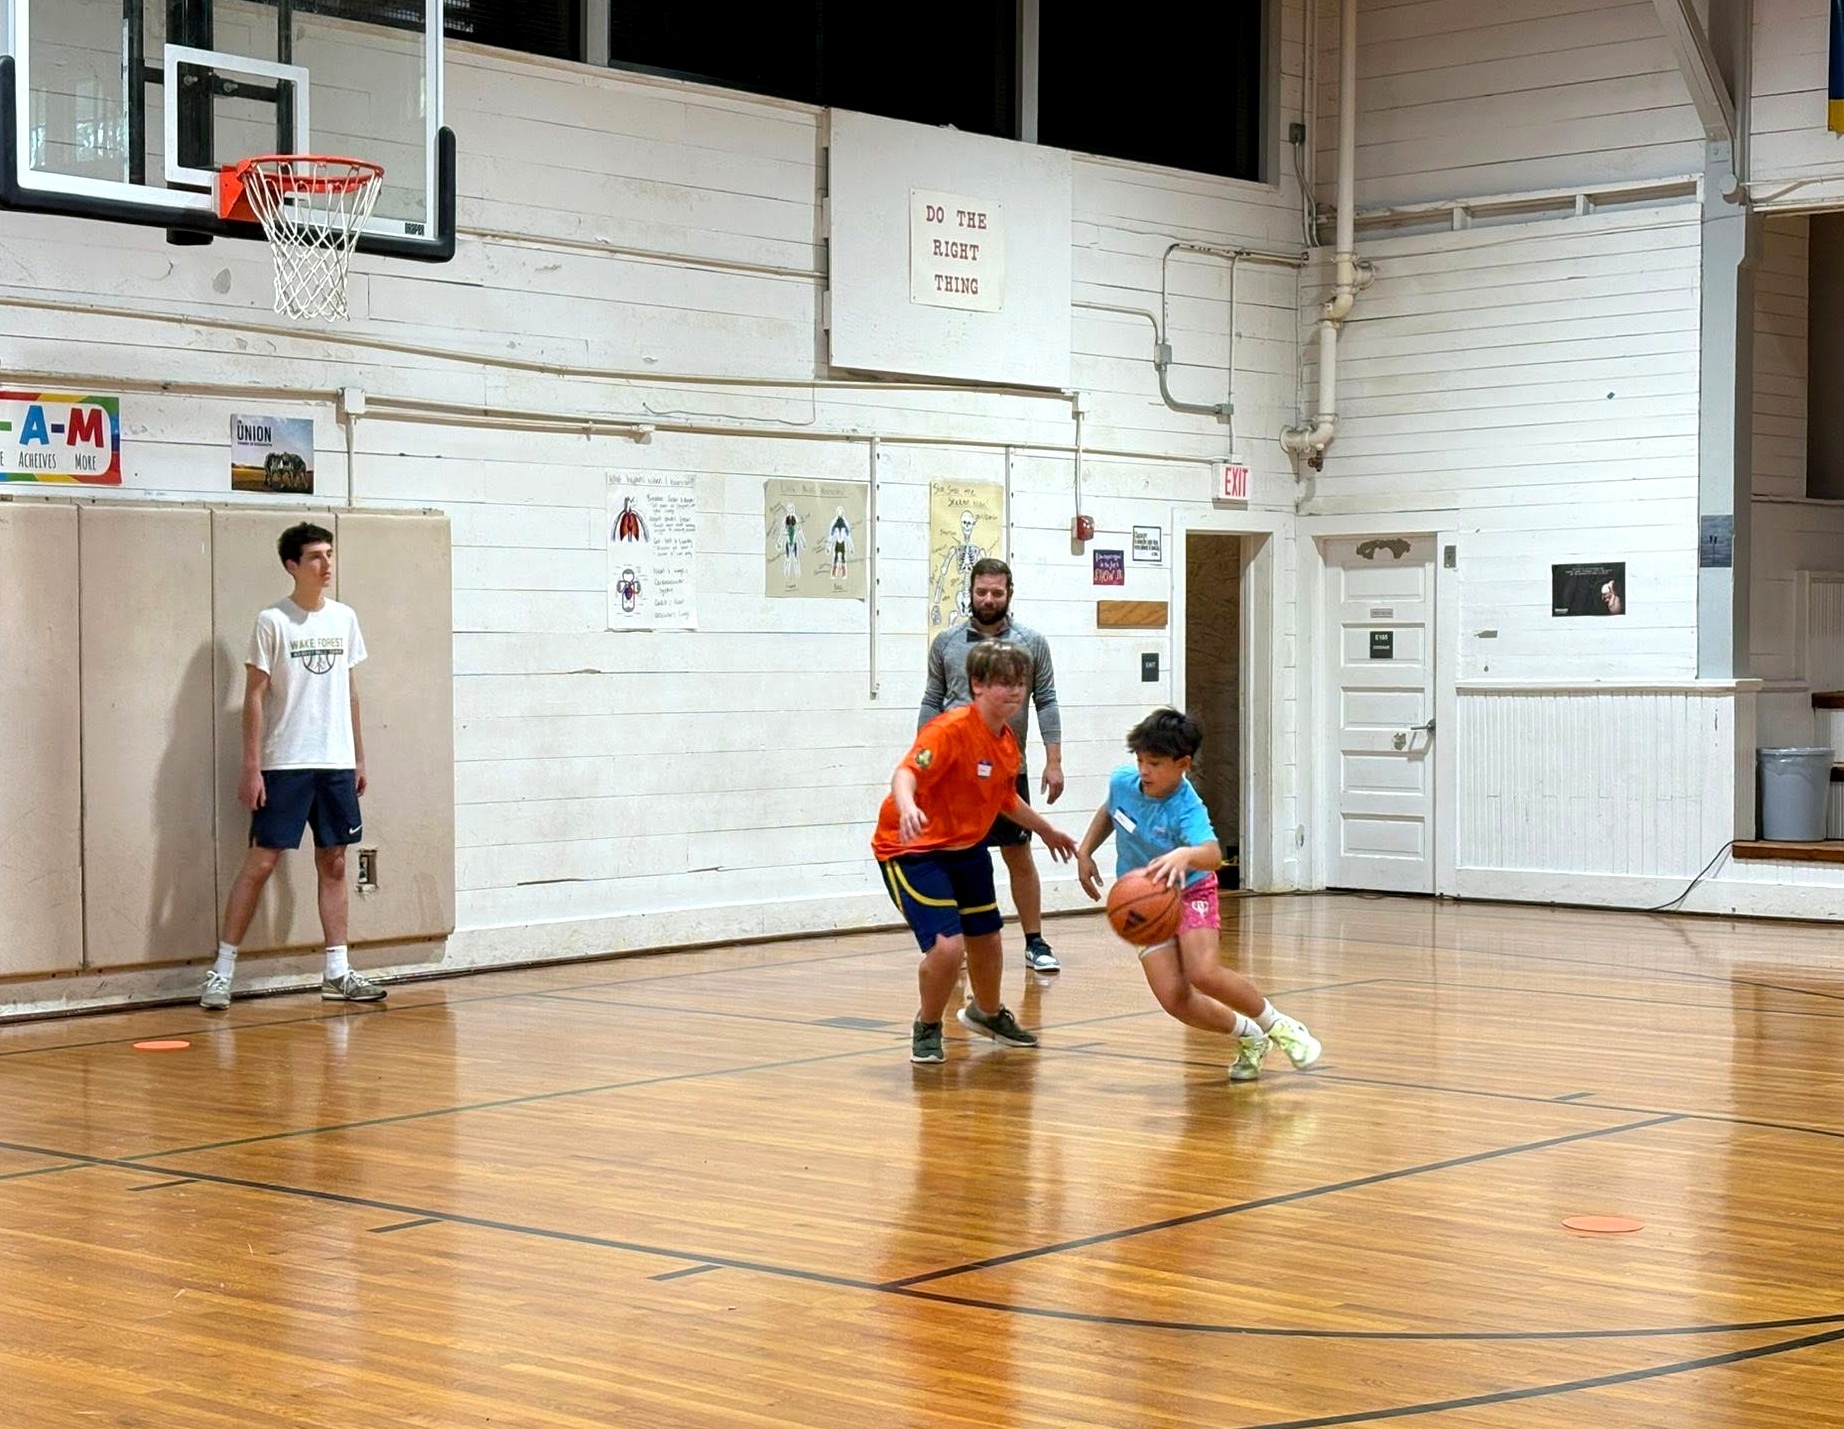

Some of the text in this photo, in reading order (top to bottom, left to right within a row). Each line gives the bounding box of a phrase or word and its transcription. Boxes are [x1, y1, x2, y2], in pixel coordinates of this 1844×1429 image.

[926, 205, 987, 230] DO THE
[933, 239, 979, 261] RIGHT
[935, 274, 979, 295] THING
[237, 424, 272, 442] UNION
[1225, 466, 1248, 497] EXIT
[290, 637, 343, 650] WAKE FOREST
